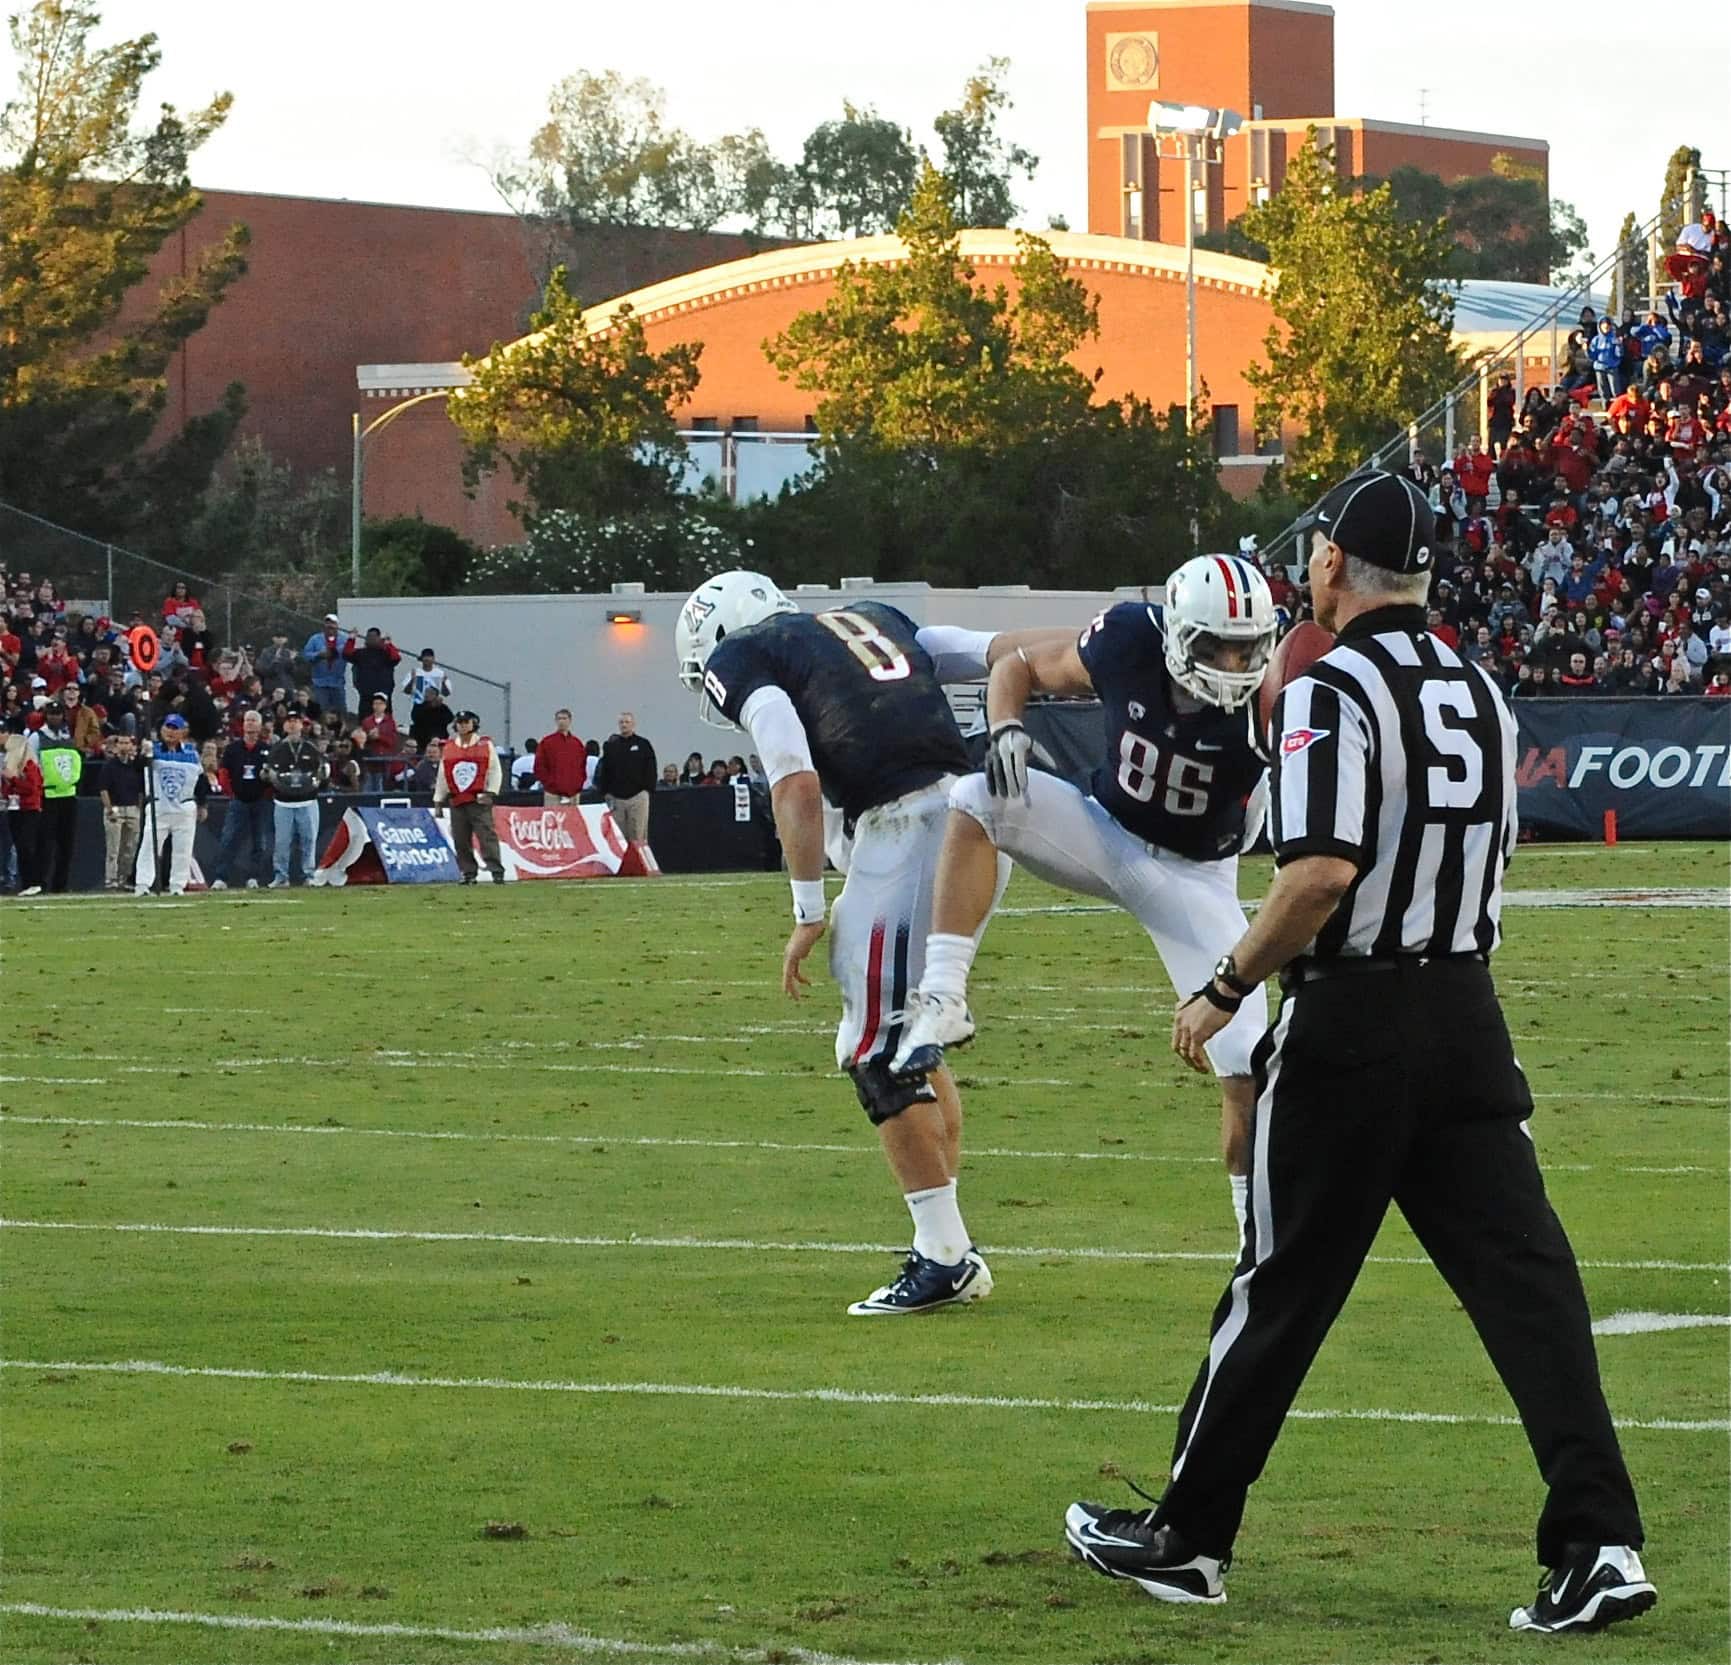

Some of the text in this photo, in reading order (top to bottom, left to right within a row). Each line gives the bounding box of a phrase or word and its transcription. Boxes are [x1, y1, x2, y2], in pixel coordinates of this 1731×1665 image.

[816, 611, 911, 681] 8
[704, 670, 727, 707] 8
[1418, 679, 1484, 808] S
[1118, 730, 1214, 816] 85
[377, 822, 428, 844] Game
[381, 842, 449, 870] Sponsor
